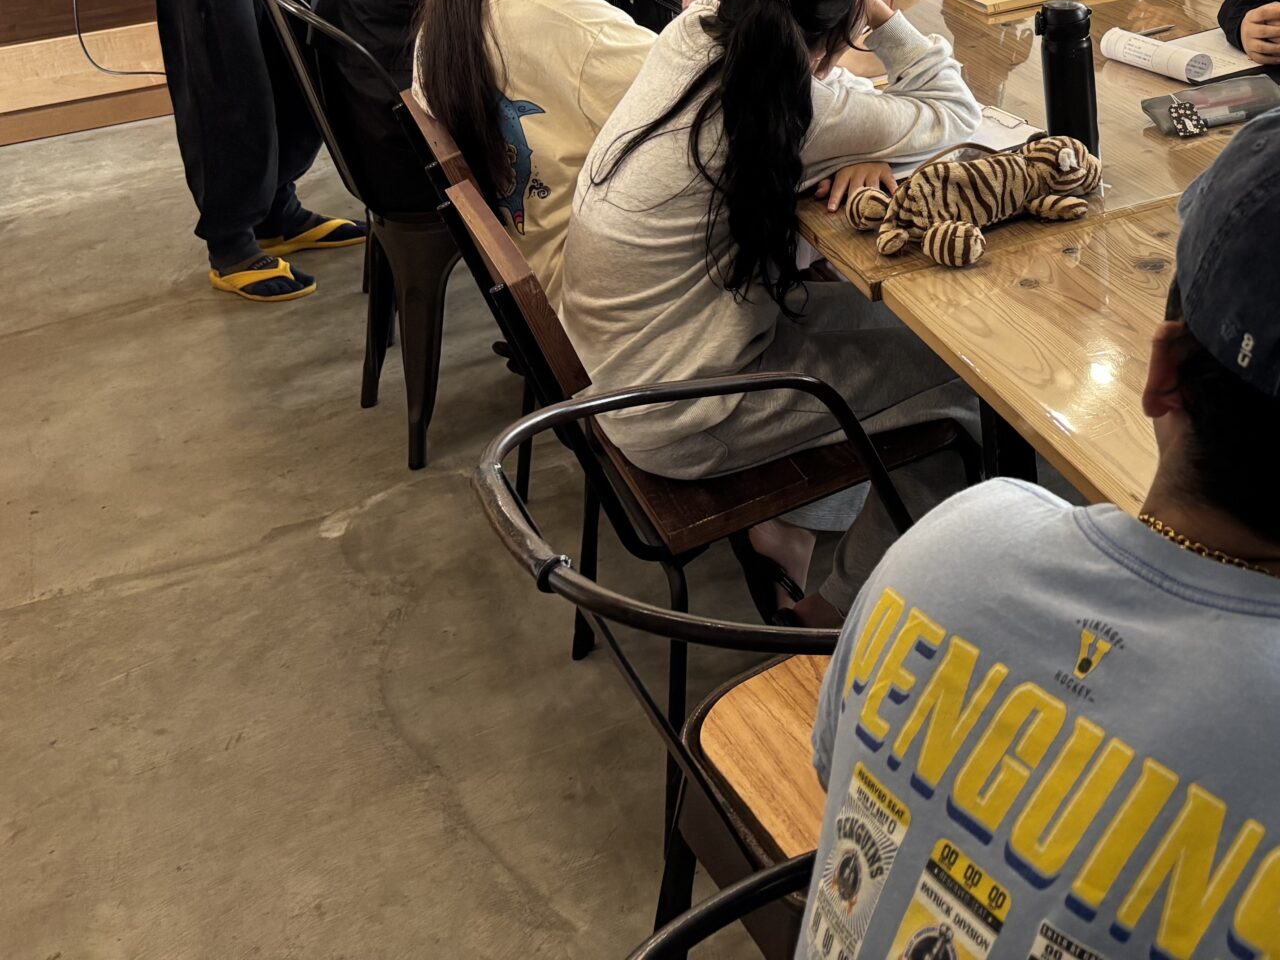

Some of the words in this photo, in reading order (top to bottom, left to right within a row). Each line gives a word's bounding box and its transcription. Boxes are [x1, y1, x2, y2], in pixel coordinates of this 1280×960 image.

[1082, 618, 1124, 647] VINTAGE
[1055, 670, 1092, 700] HOCKEY
[887, 795, 905, 819] SEAT
[837, 816, 885, 879] PENGUINS
[921, 881, 952, 915] PATRICK
[953, 906, 991, 951] DIVISION
